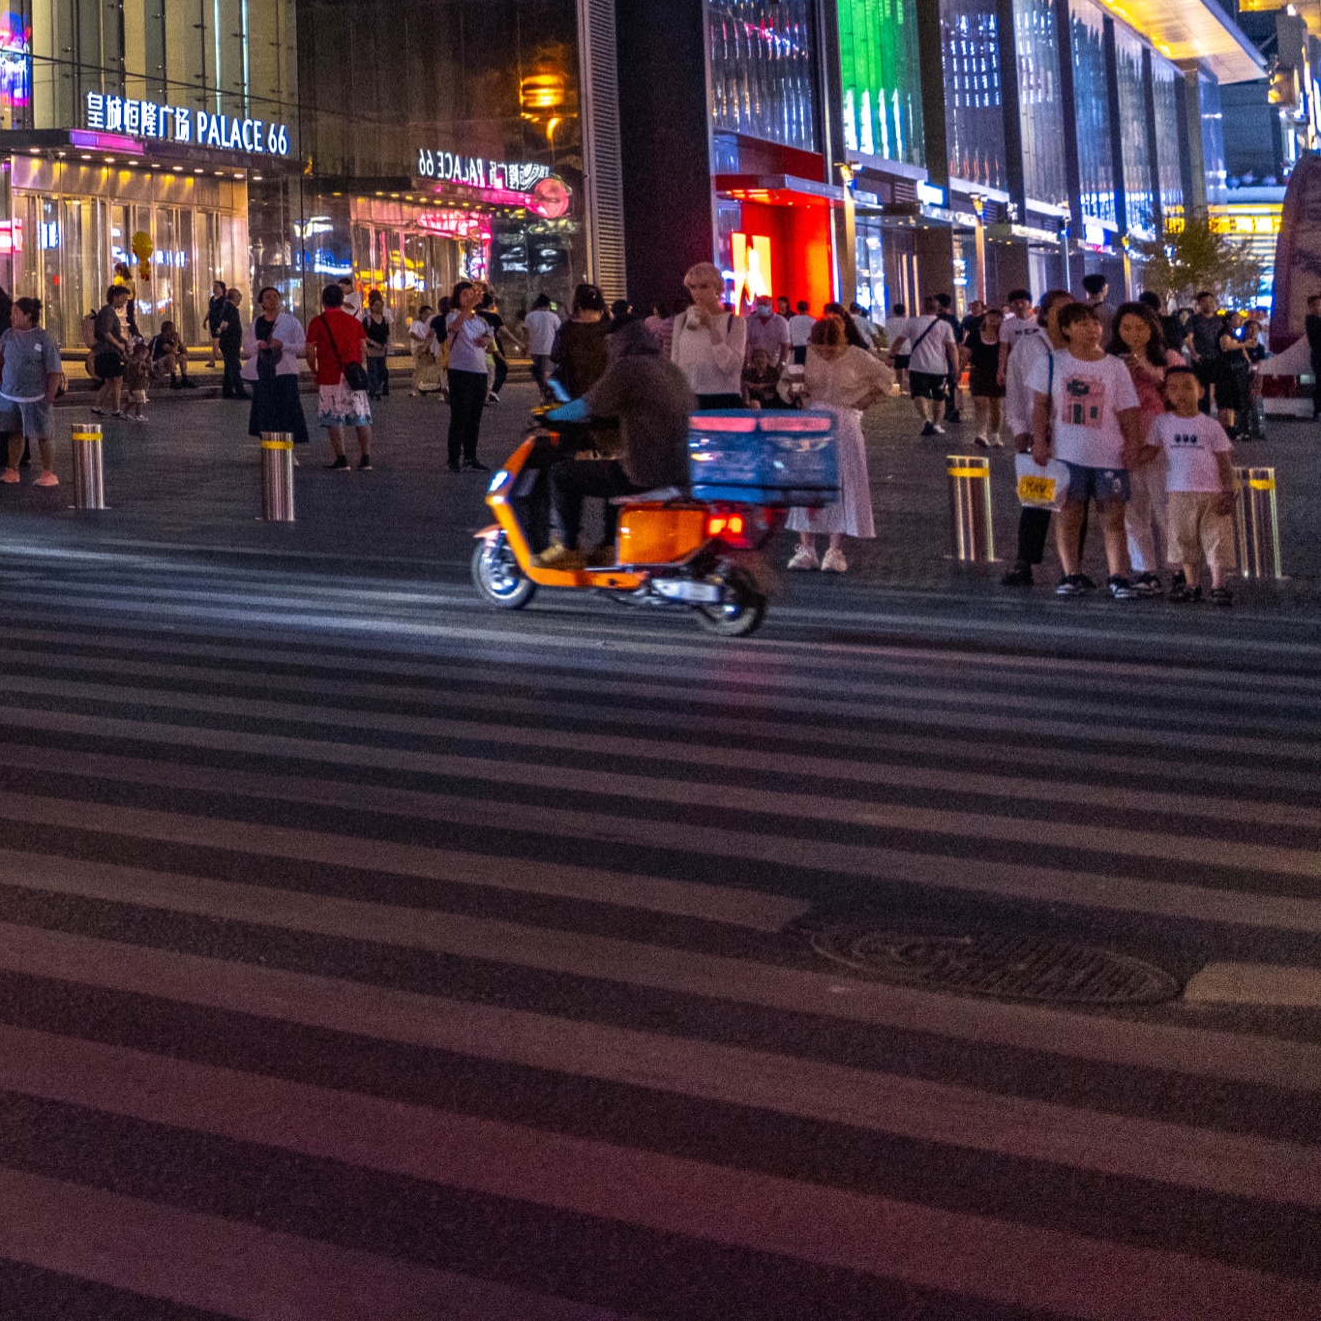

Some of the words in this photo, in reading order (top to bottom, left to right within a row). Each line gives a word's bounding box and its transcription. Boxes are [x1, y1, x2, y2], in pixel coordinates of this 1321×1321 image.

[87, 92, 191, 142] 皇城恒隆广场
[197, 111, 264, 153] PALACE
[267, 123, 288, 155] 66
